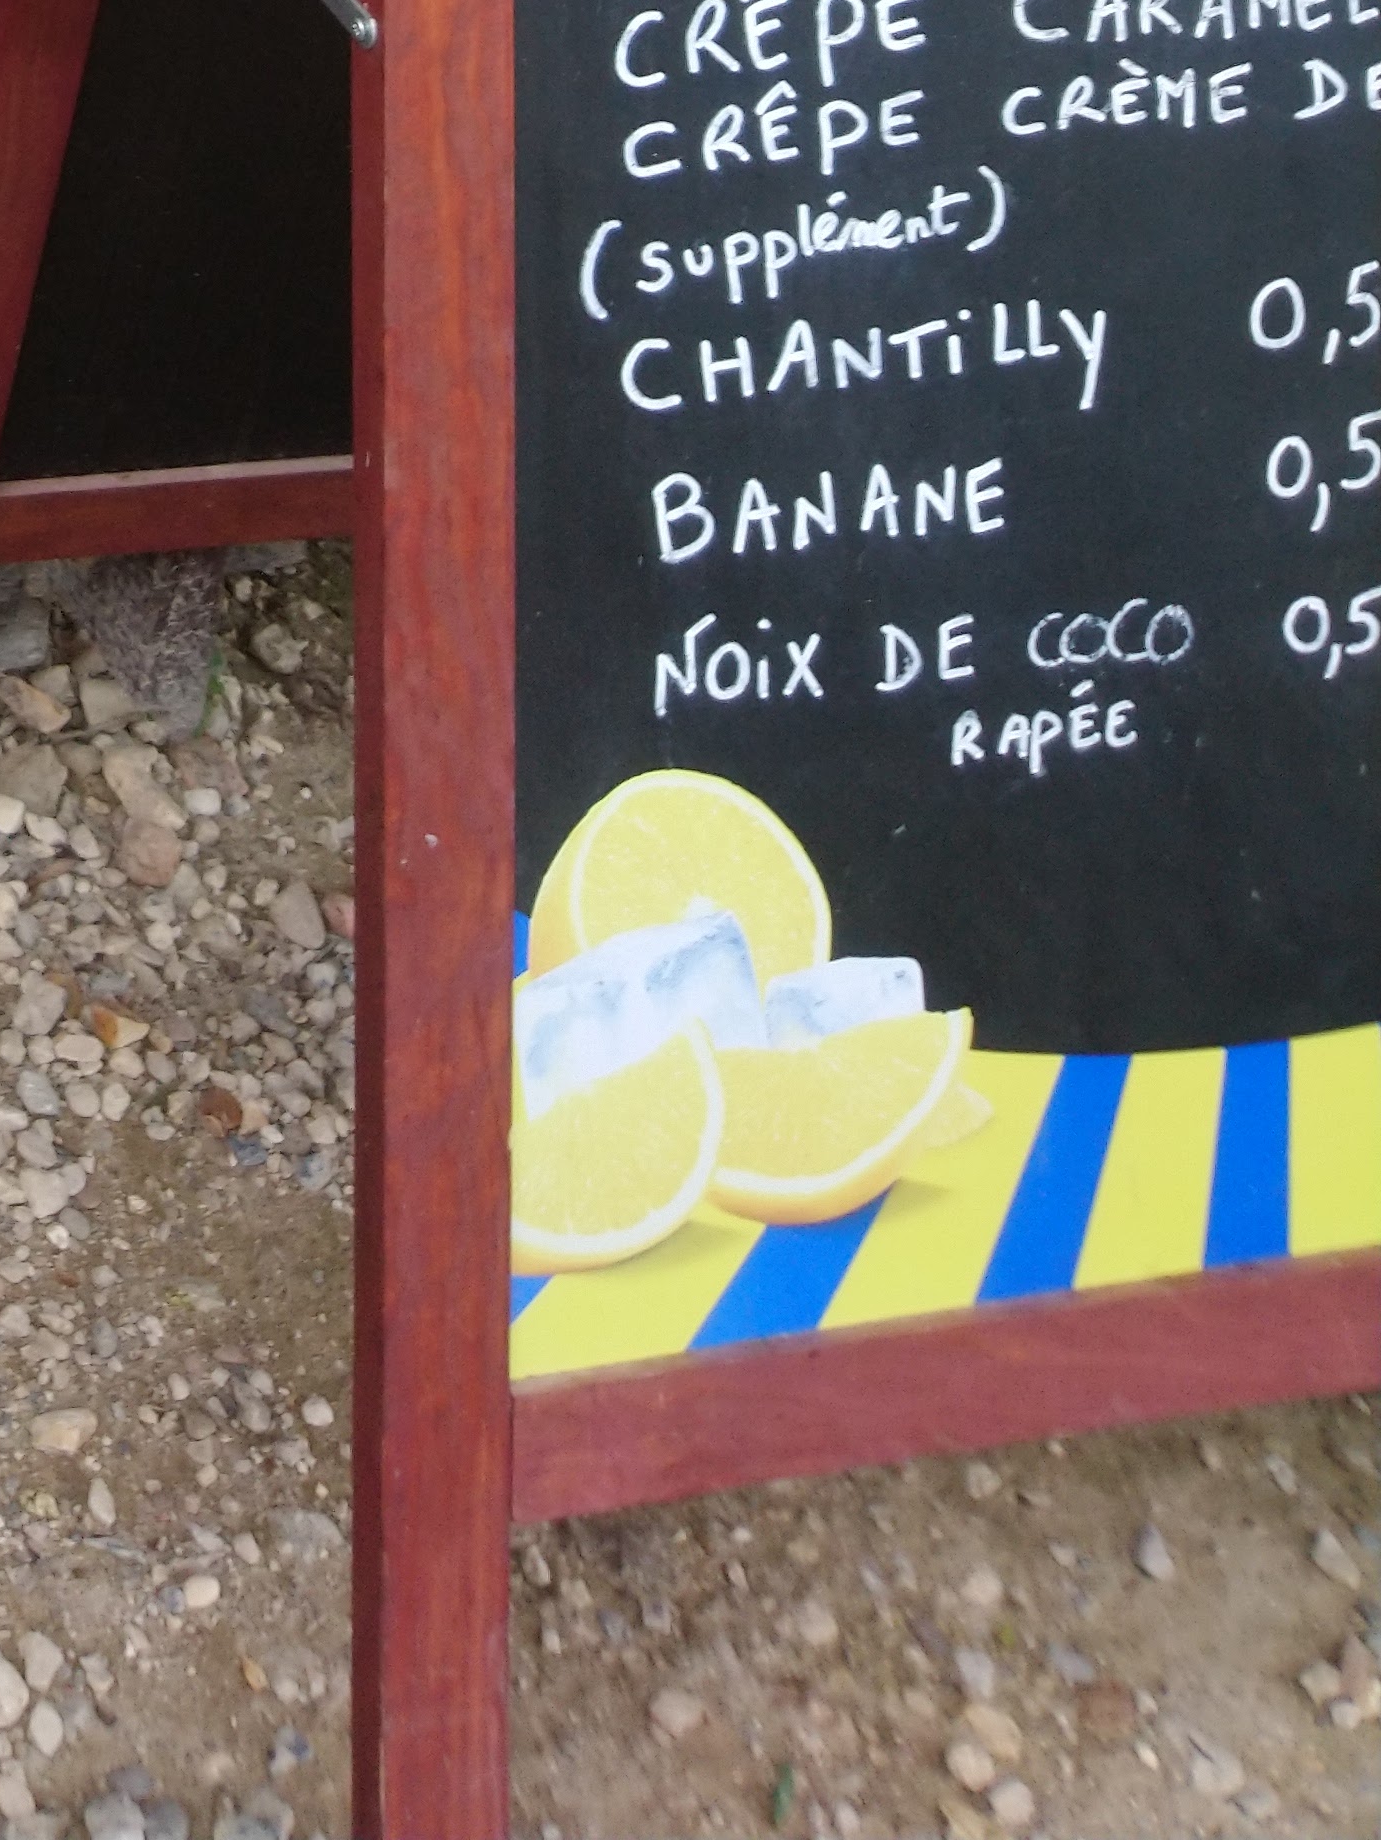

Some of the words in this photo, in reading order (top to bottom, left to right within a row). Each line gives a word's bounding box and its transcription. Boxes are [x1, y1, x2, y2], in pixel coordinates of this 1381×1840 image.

[622, 80, 924, 177] CRÊPE
[1001, 58, 1253, 136] CRÈME
[651, 457, 1005, 563] BANANE
[875, 614, 974, 692] DE
[1027, 598, 1195, 666] COCO
[951, 679, 1139, 778] RAPÉE
